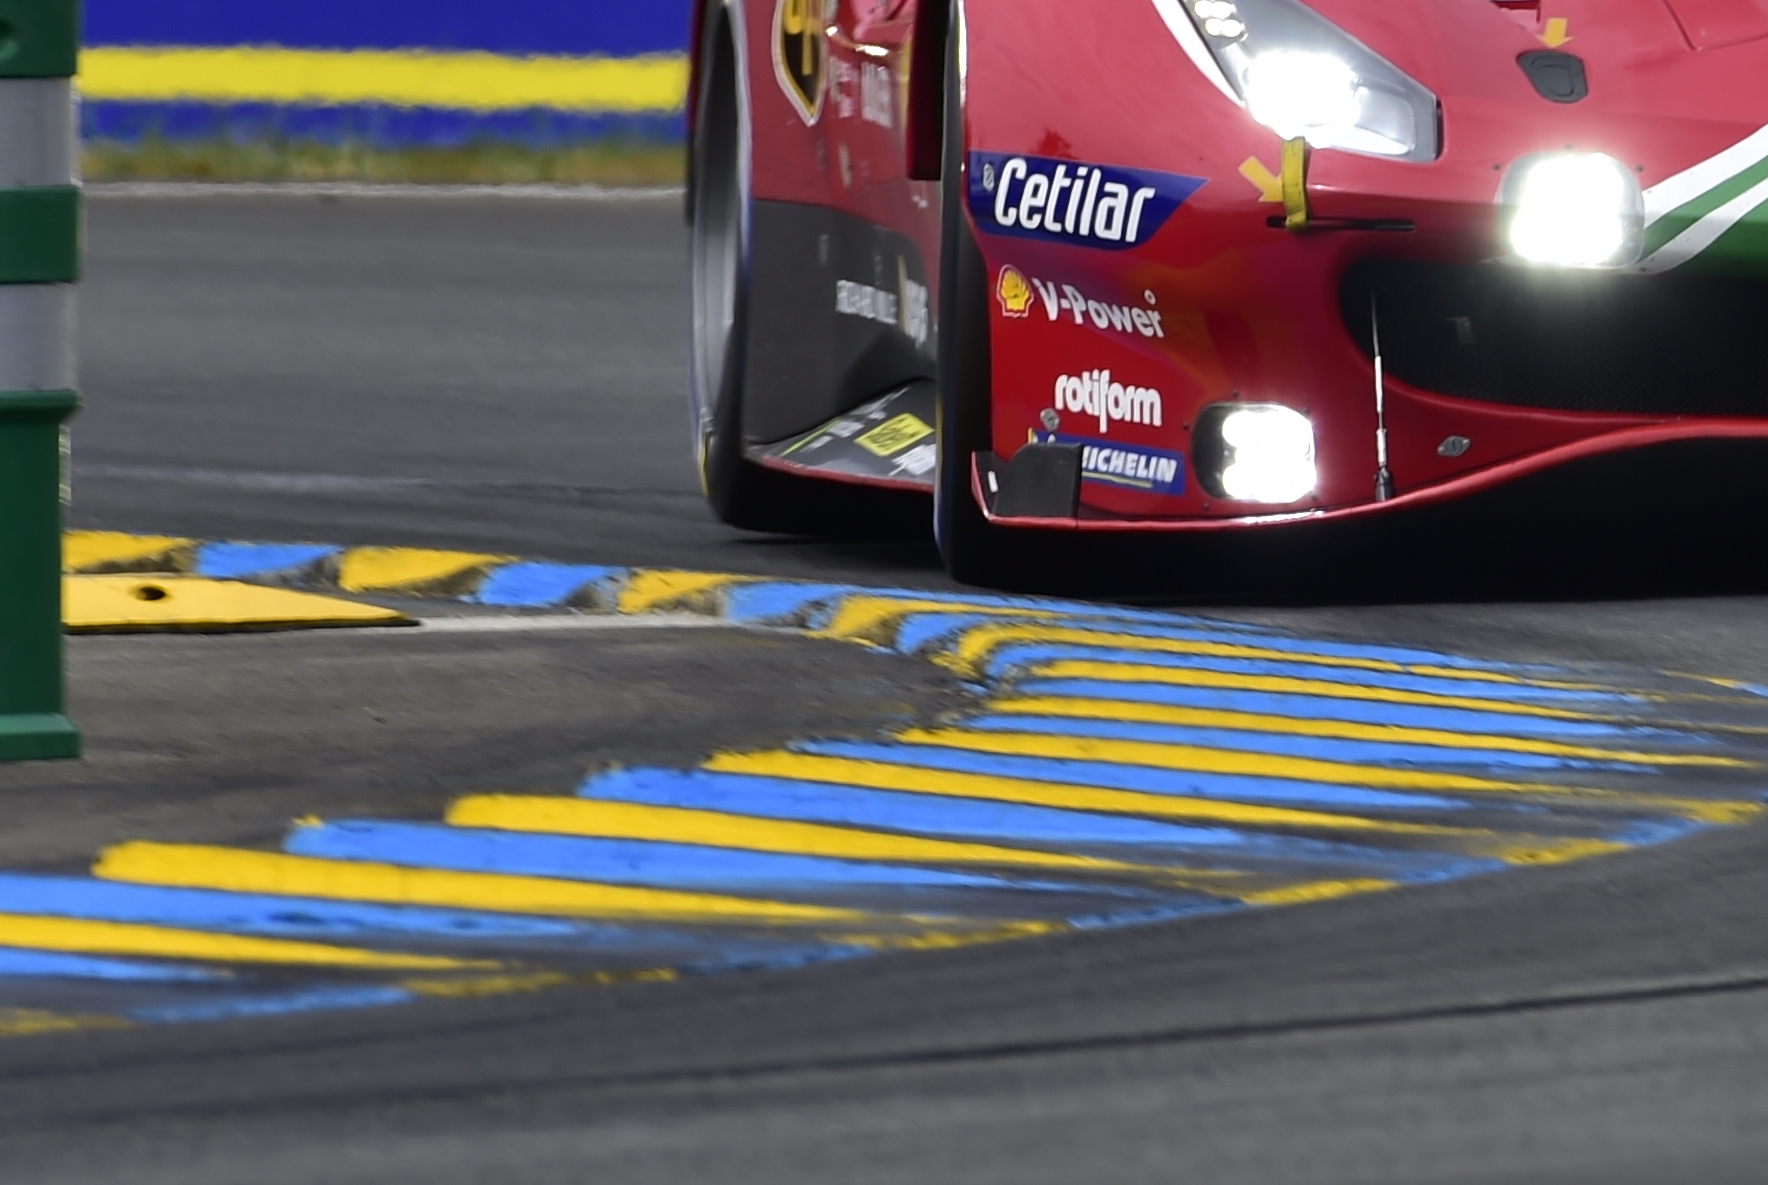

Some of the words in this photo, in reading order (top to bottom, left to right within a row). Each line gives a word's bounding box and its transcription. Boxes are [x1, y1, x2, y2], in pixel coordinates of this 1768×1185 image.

[994, 157, 1156, 243] Cetilar
[1032, 278, 1165, 339] V-Power
[1055, 369, 1162, 434] rotiform
